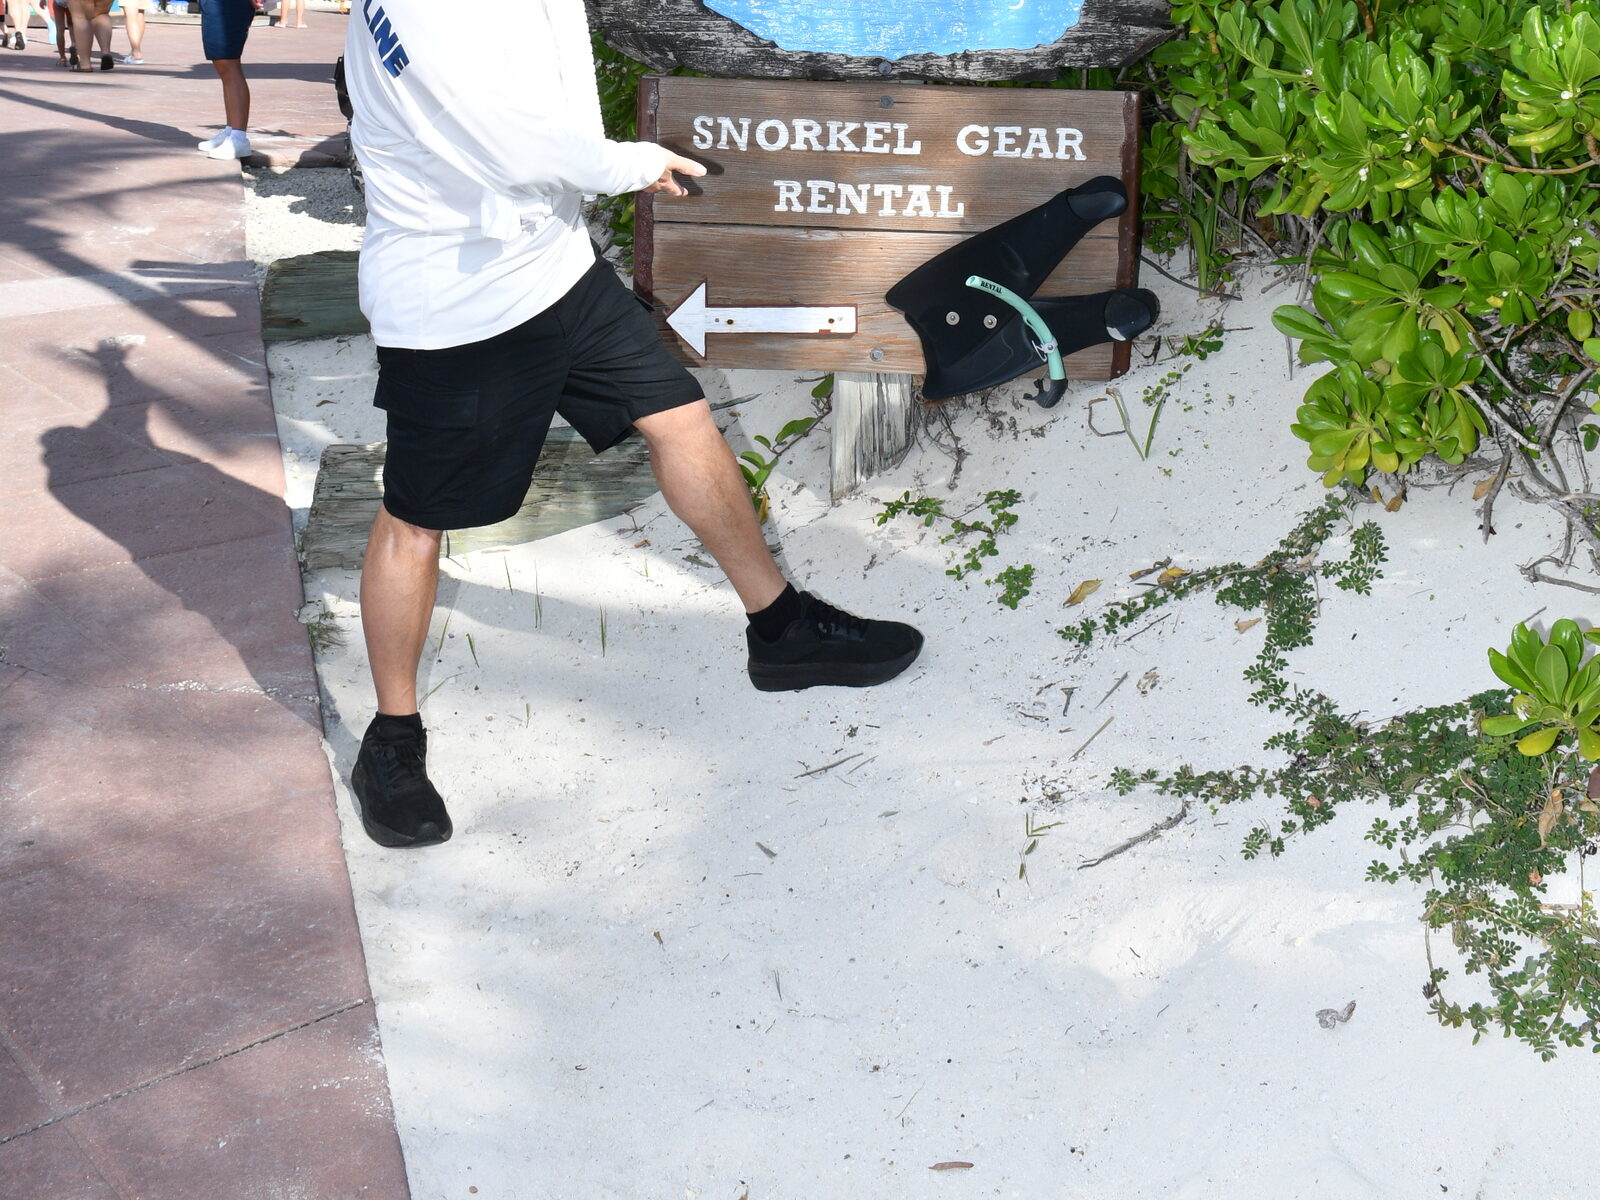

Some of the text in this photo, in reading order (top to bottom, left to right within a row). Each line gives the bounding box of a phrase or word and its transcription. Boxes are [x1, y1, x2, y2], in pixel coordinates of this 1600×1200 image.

[693, 115, 1087, 161] SNORKEL GEAR
[773, 179, 965, 218] RENTAL
[980, 280, 1003, 294] RENTAL
